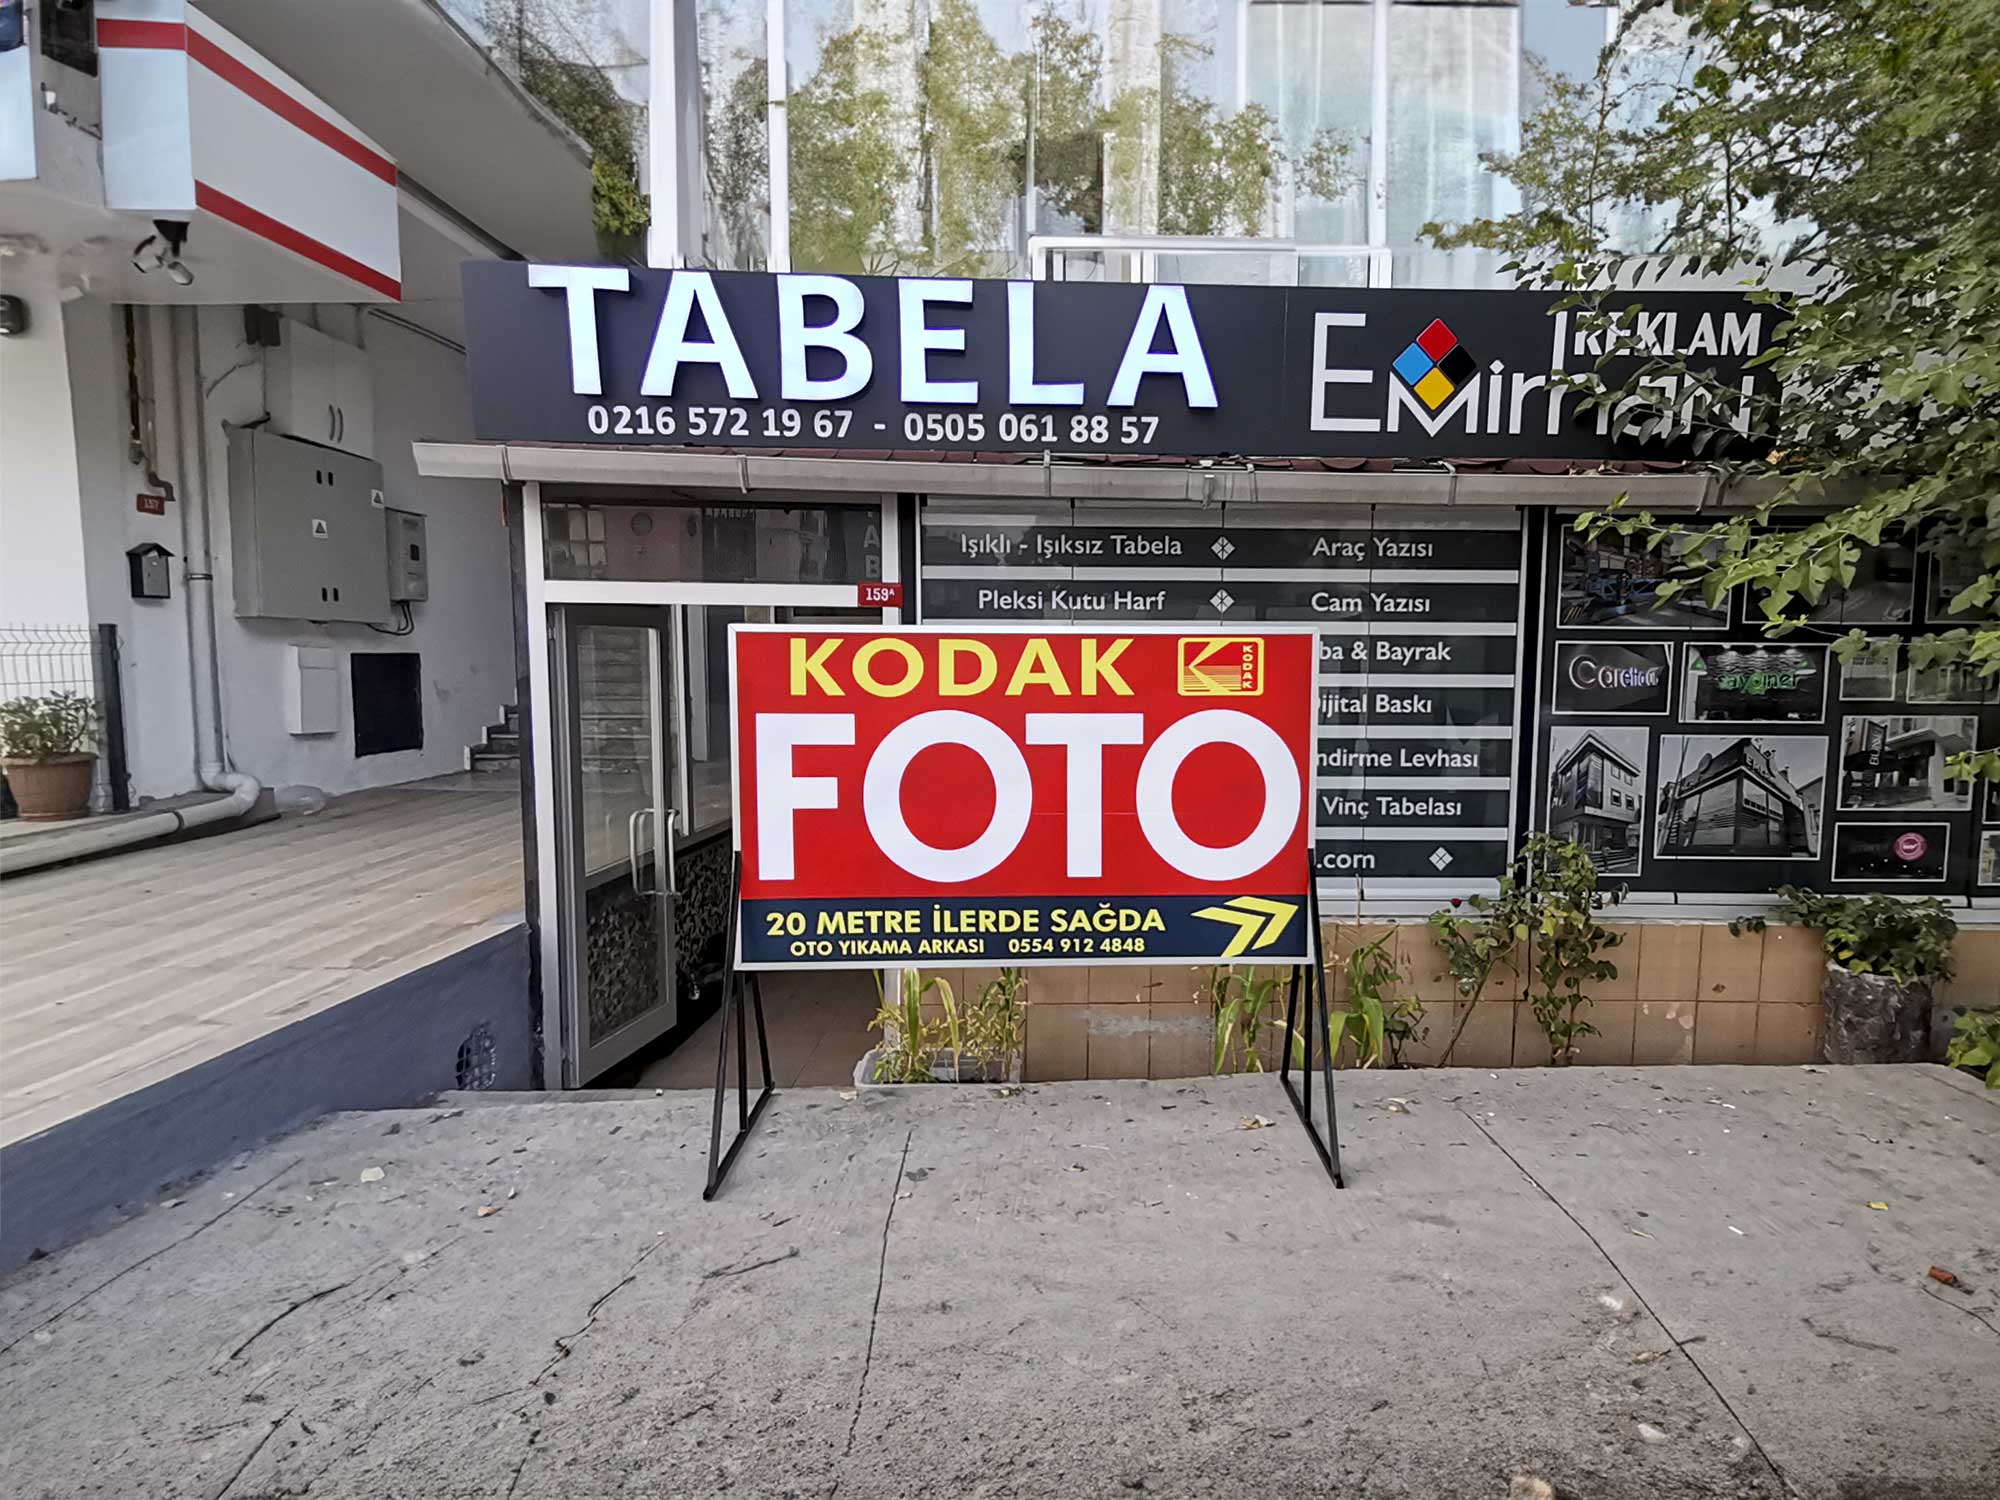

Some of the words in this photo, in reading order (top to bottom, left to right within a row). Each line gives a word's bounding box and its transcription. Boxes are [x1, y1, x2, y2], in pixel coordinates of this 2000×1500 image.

[526, 263, 1219, 408] TABELA
[1573, 311, 1763, 356] REKLAM
[586, 405, 677, 436] 0216
[687, 406, 750, 437] 572
[761, 408, 802, 438] 19
[812, 409, 853, 439] 67
[903, 412, 986, 442] 0505
[997, 413, 1058, 443] 061
[1069, 414, 1109, 444] 88
[1119, 416, 1160, 444] 57
[960, 533, 1011, 558] Işıklı
[1036, 534, 1104, 559] Işıksız
[1110, 535, 1183, 555] Tabela
[1312, 537, 1366, 561] Araç
[1373, 537, 1434, 558] Yazısı
[978, 589, 1044, 611] Pleksi
[1051, 590, 1106, 611] Kutu
[1114, 590, 1166, 611] Harf
[1311, 592, 1363, 612] Cam
[1370, 592, 1431, 612] Yazısı
[1351, 641, 1368, 661] &
[1375, 641, 1452, 666] Bayrak
[790, 637, 1135, 698] KODAK
[1242, 645, 1254, 689] KODAK
[1319, 693, 1368, 718] ijital
[1375, 694, 1433, 714] Baskı
[1399, 748, 1479, 768] Levhası
[754, 708, 1302, 883] FOTO
[1322, 796, 1370, 820] Vinç
[1375, 796, 1463, 816] Tabelası
[1317, 854, 1376, 869] .com
[766, 911, 806, 936] 20
[816, 910, 921, 935] METRE
[933, 904, 1041, 934] İLERDE
[1050, 902, 1167, 933] SAĞDA
[790, 940, 834, 956] OTO
[838, 939, 914, 956] YIKAMA
[917, 938, 985, 954] ARKASI
[1007, 938, 1055, 954] 0554
[1060, 938, 1095, 953] 912
[1099, 937, 1146, 953] 4848
